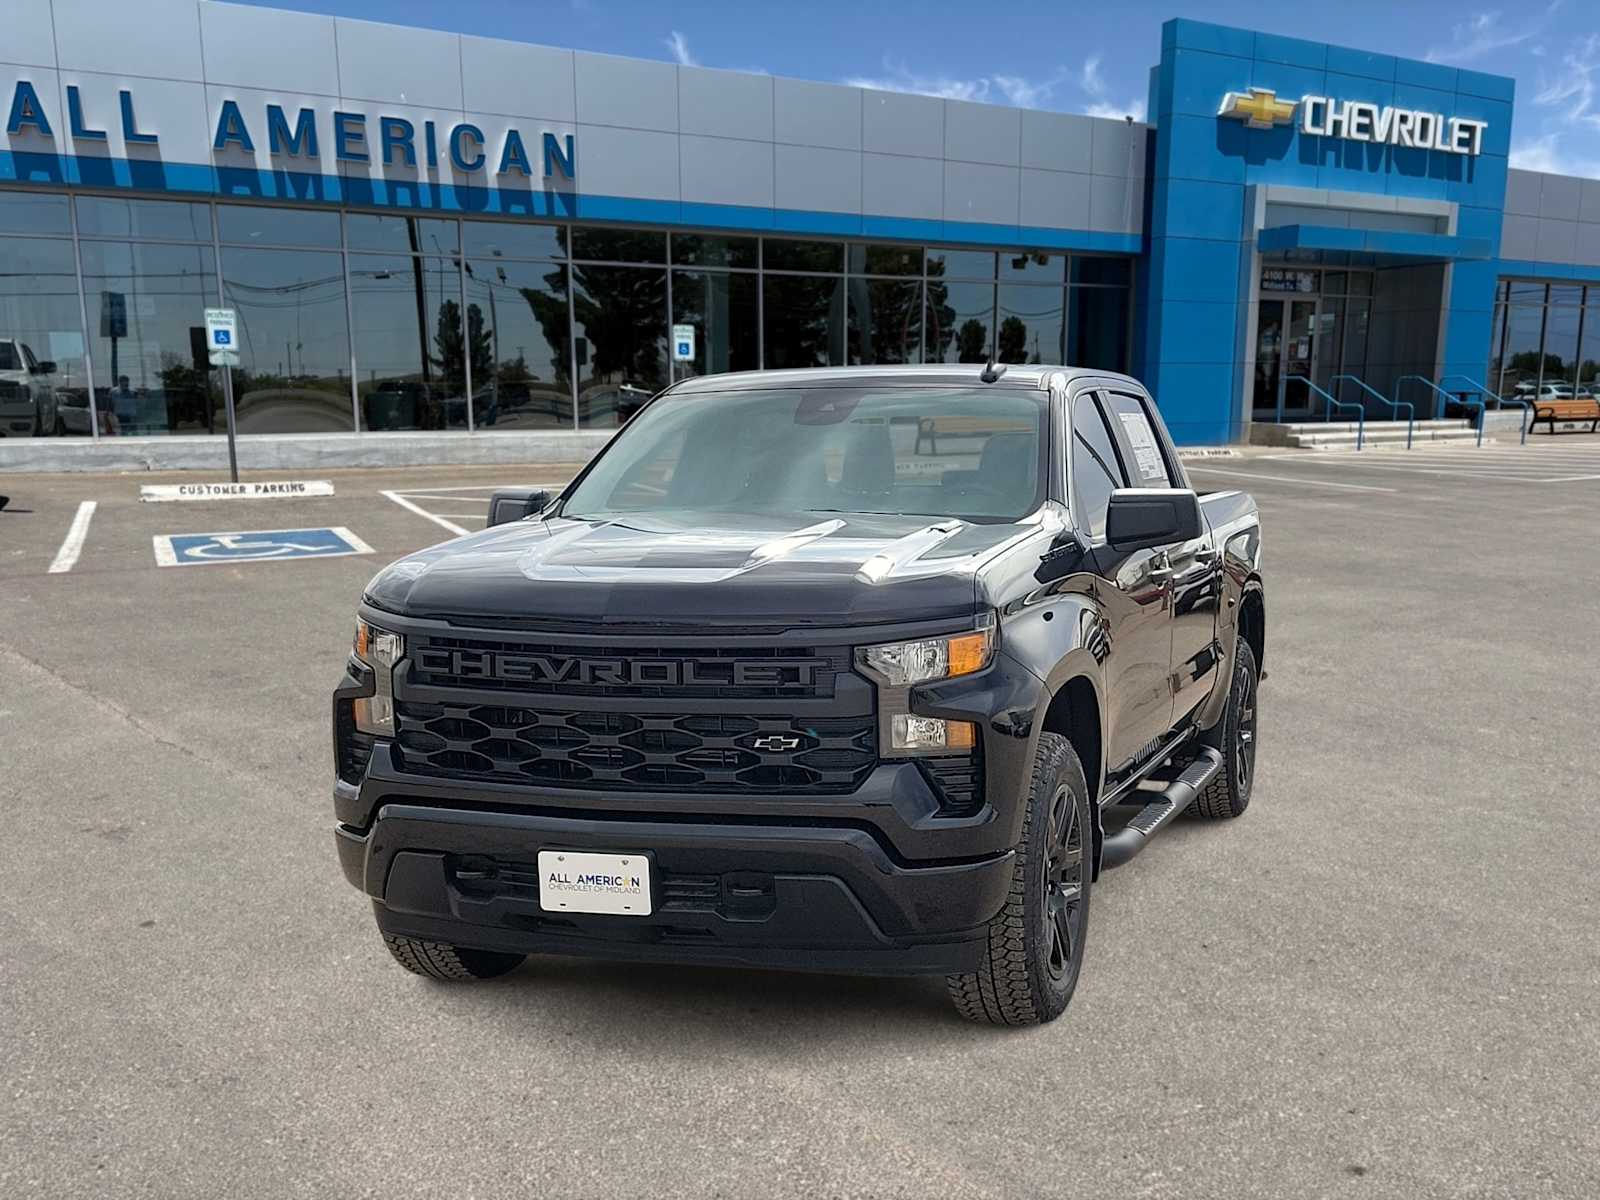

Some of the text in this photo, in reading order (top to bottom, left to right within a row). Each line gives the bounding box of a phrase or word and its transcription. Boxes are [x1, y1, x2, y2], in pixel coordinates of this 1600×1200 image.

[6, 80, 576, 180] ALL AMERICAN
[1301, 93, 1488, 155] CHEVROLET
[179, 483, 306, 495] CUSTOMER PARKING
[415, 647, 833, 687] CHEVROLET
[548, 873, 571, 884] ALL
[548, 883, 641, 895] CHEVROLET OF MIDLAND
